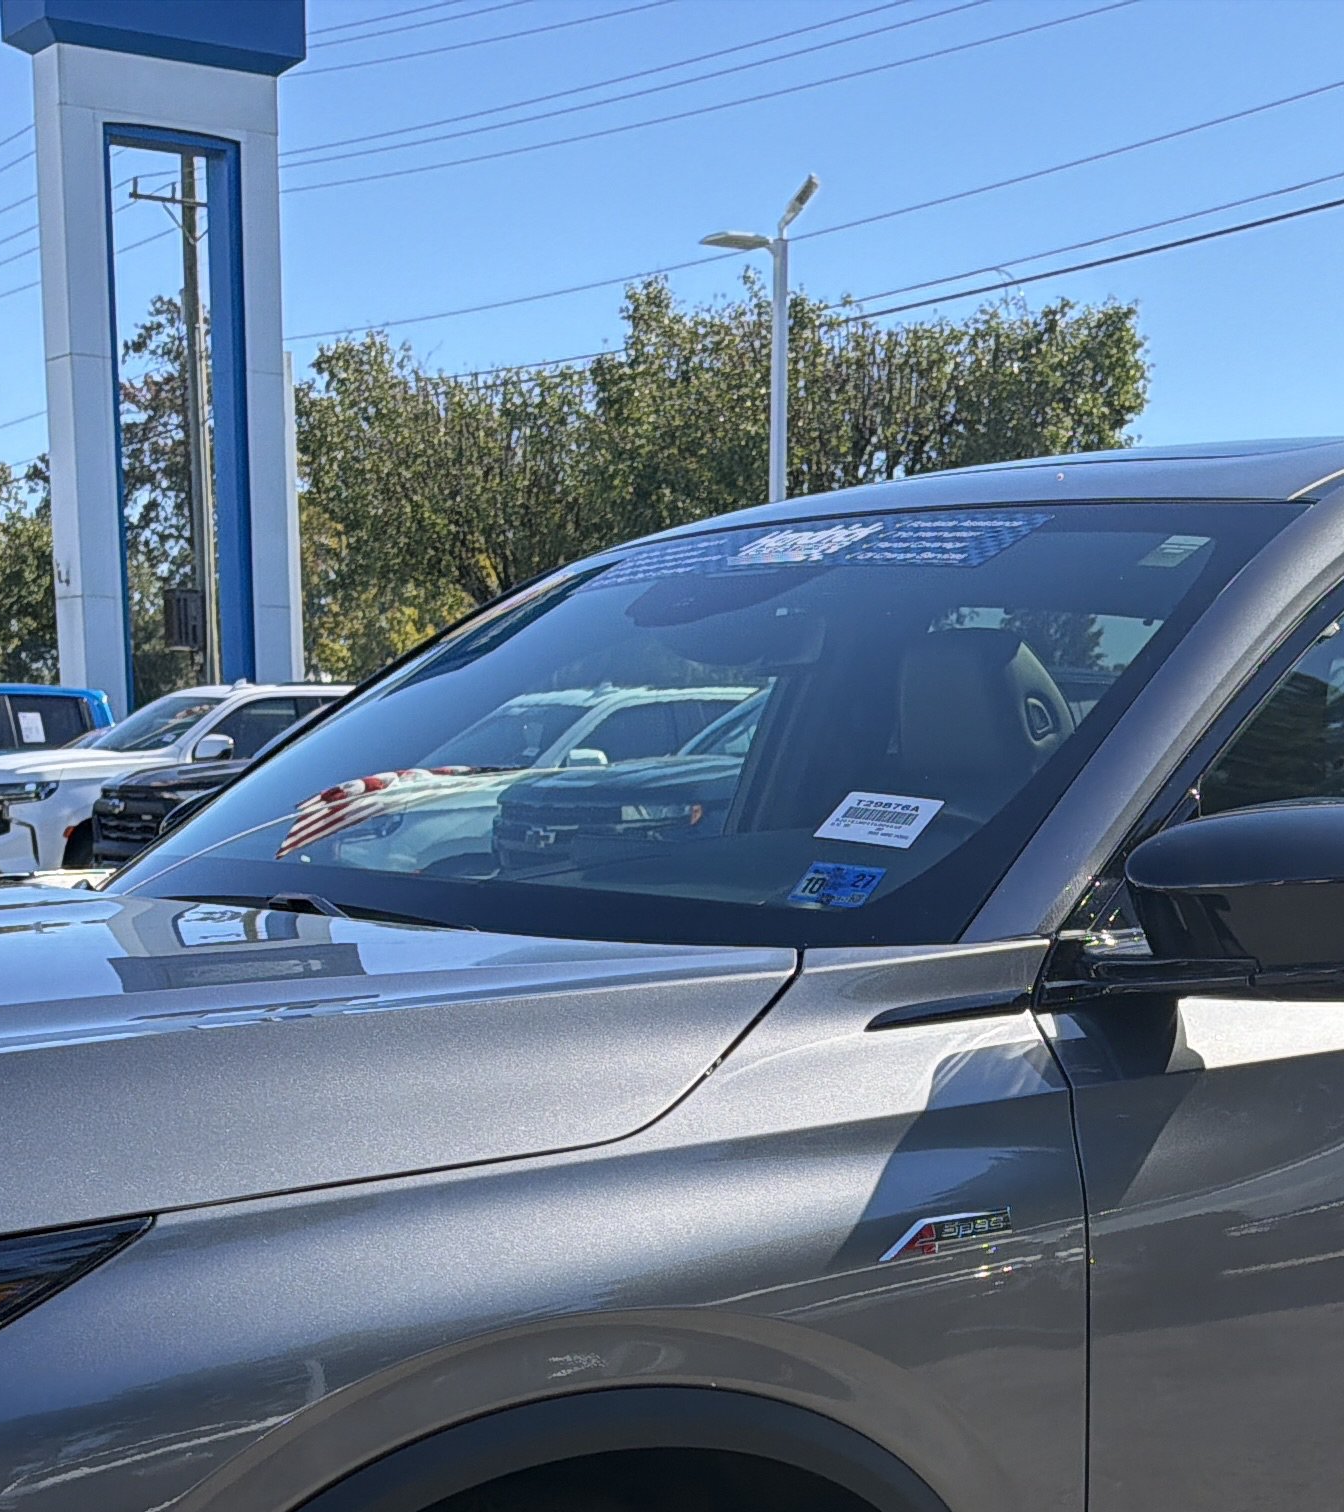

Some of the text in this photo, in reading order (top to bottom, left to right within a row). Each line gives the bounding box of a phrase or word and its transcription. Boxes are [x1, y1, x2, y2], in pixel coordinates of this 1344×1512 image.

[856, 799, 920, 813] T29876A
[801, 874, 877, 895] 10 27
